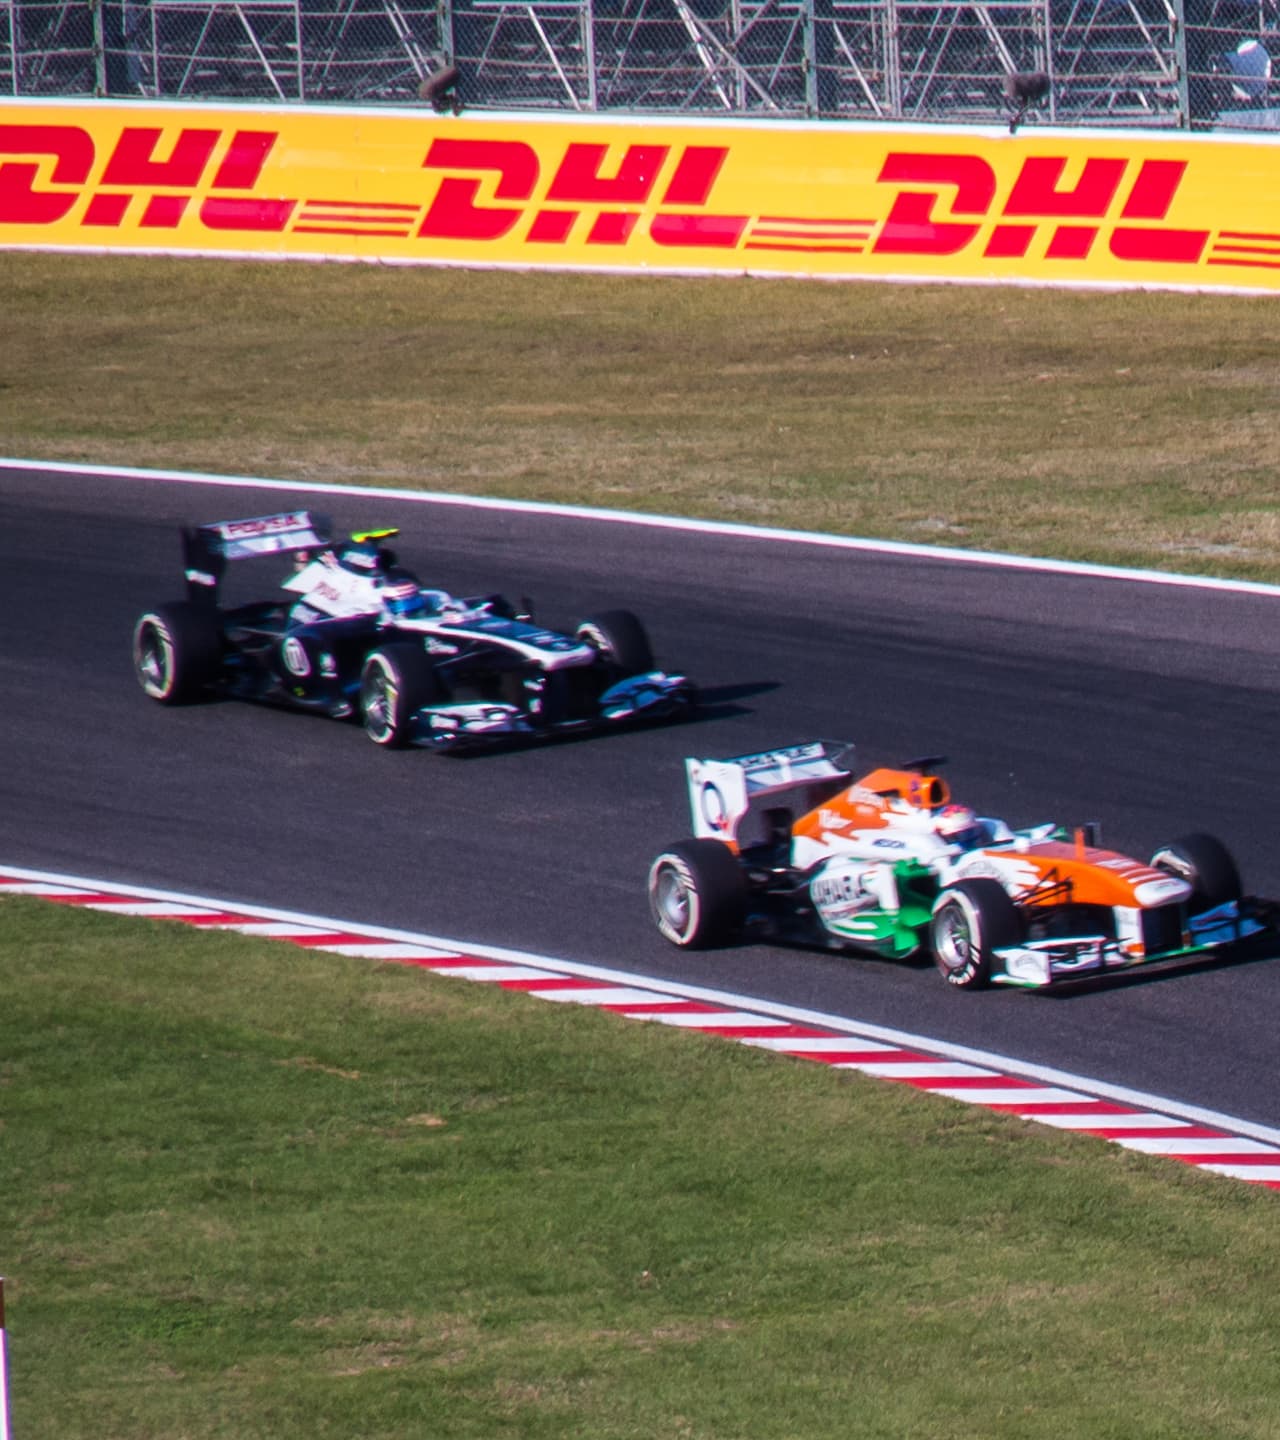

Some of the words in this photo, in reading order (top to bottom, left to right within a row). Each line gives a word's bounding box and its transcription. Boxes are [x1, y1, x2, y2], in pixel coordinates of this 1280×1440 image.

[0, 124, 297, 231] DHL
[417, 137, 748, 248] DHL
[872, 152, 1210, 264] DHL
